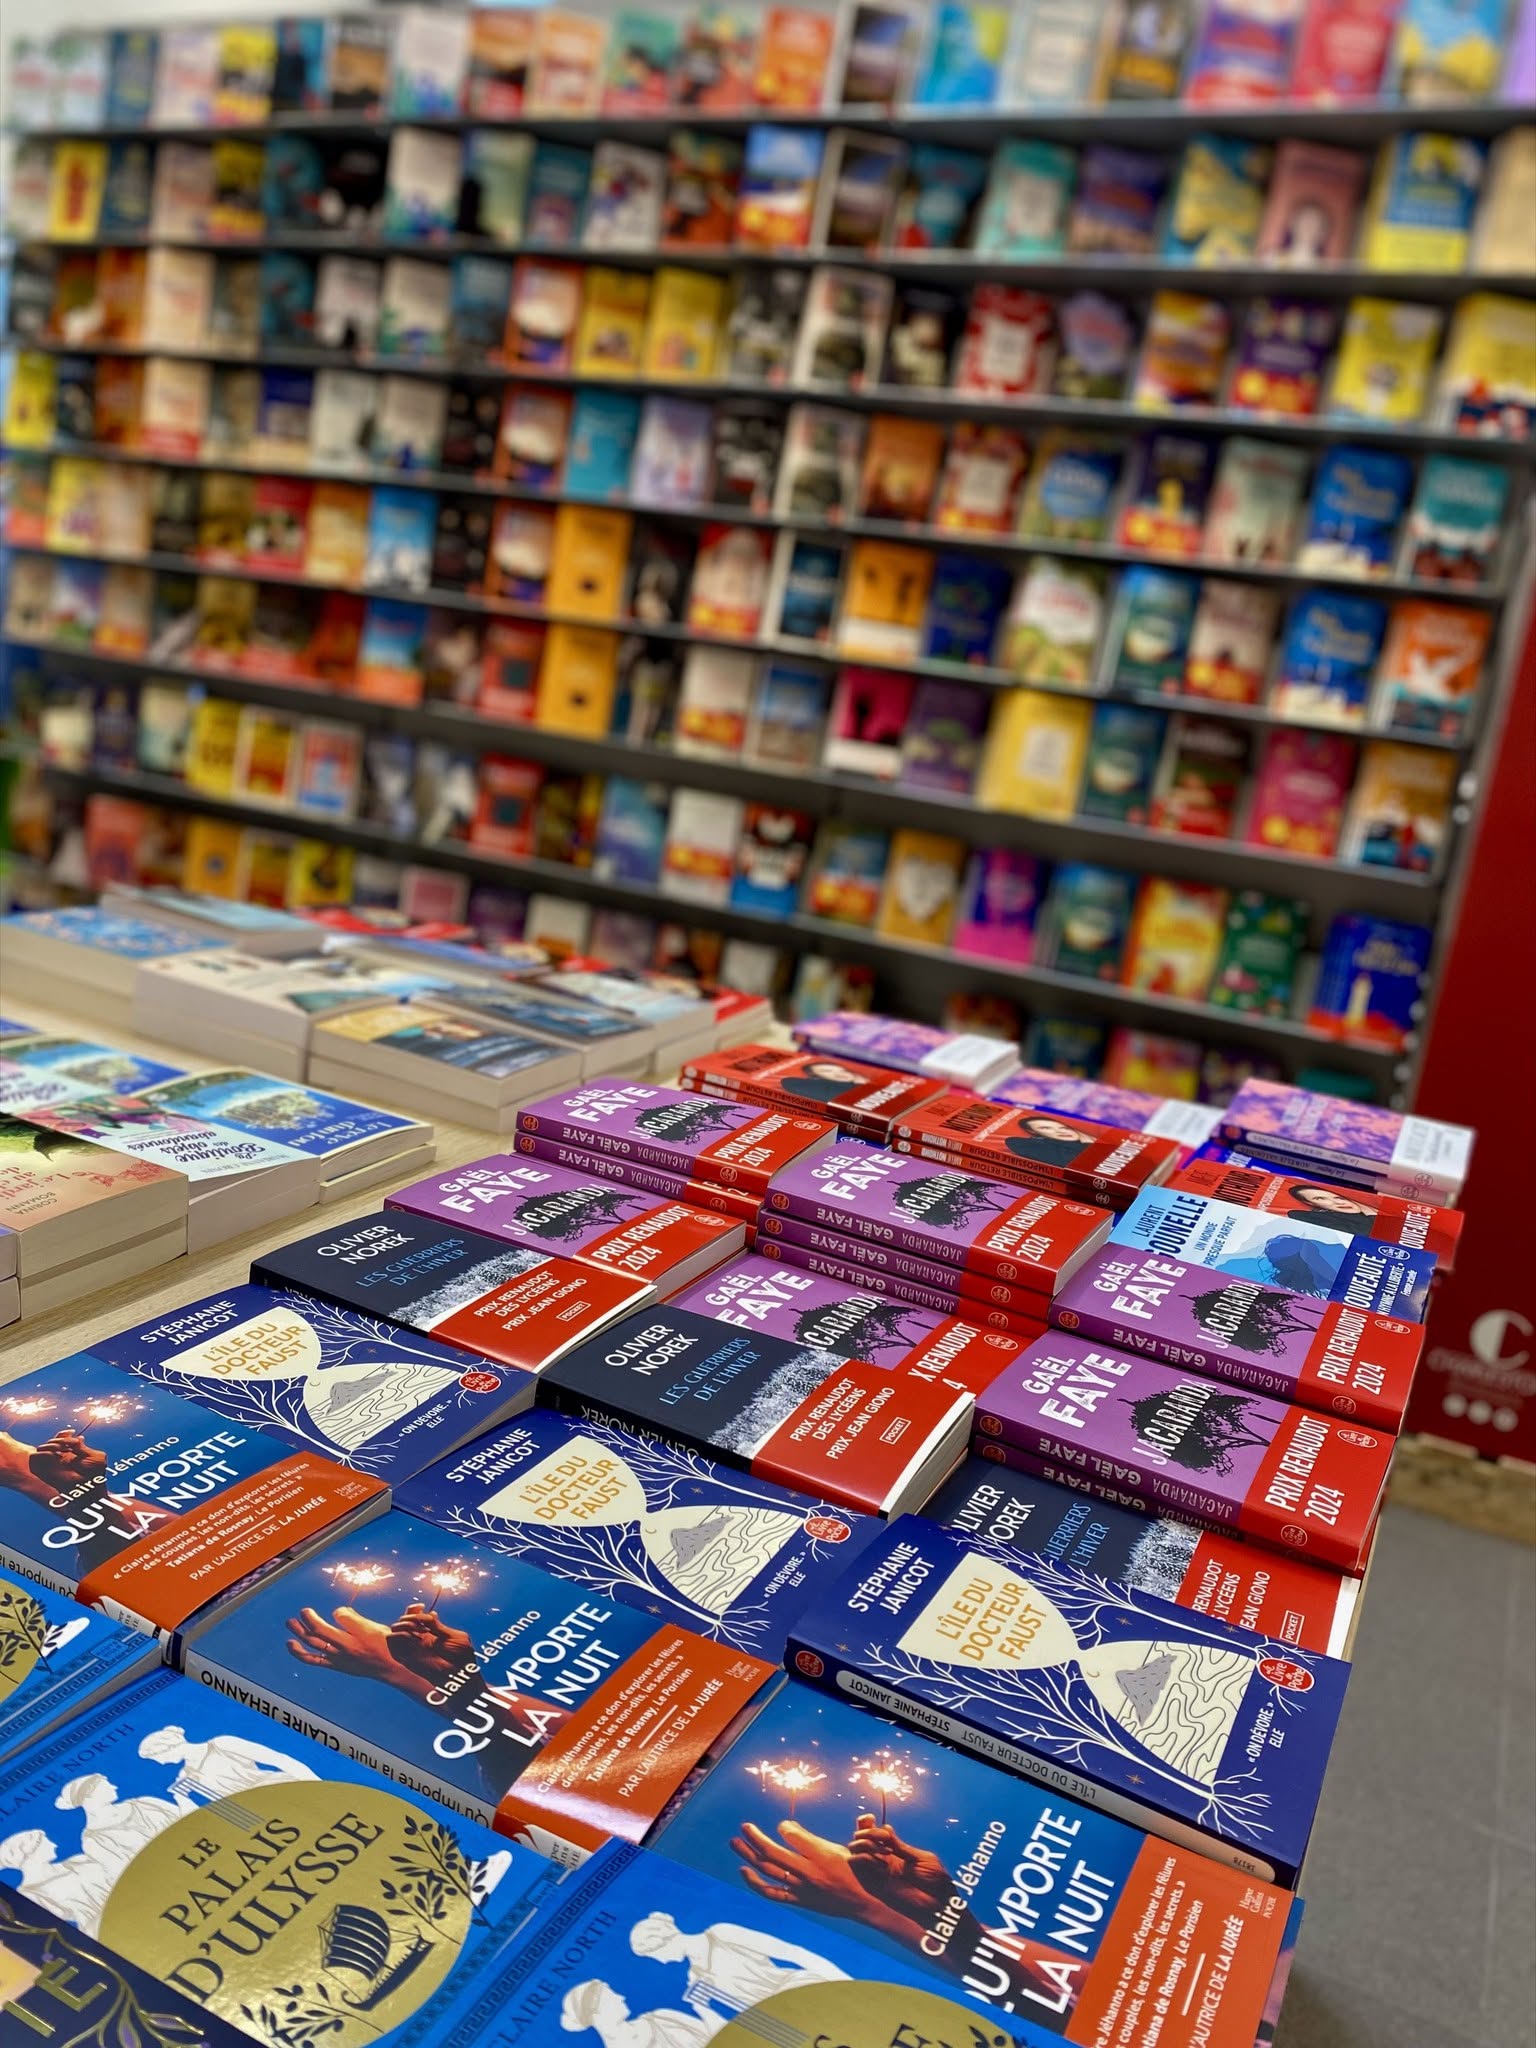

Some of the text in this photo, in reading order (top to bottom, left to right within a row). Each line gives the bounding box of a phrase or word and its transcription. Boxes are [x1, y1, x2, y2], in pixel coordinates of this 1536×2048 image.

[562, 1088, 616, 1108] GAËL
[566, 1086, 659, 1123] FAYE
[628, 1096, 718, 1140] JACARANDA
[738, 1146, 776, 1168] 2024
[810, 1153, 861, 1180] GAËL
[819, 1153, 909, 1201] FAYE
[1093, 1139, 1148, 1177] NOUVEAUTÉ
[438, 1169, 504, 1193] GAËL
[438, 1167, 553, 1214] FAYE
[888, 1170, 976, 1225] JACARANDA
[502, 1182, 618, 1237] JACARANDA
[628, 1204, 696, 1245] RENAUDOT
[1006, 1194, 1063, 1235] RENAUDOT
[1132, 1204, 1168, 1239] LAURENT
[1398, 1210, 1432, 1250] OUVEAUTÉ
[317, 1225, 395, 1257] OLIVIER
[339, 1233, 416, 1265] NOREK
[1016, 1233, 1056, 1262] 2024
[1200, 1221, 1219, 1245] MONDE
[1202, 1215, 1239, 1267] PRESQUE PARFAIT
[356, 1238, 465, 1288] LES GUERRIERS
[412, 1249, 469, 1275] L'HIVER
[618, 1244, 663, 1272] 2024
[1093, 1261, 1138, 1293] GAËL
[497, 1270, 555, 1303] RENAUDOT
[520, 1276, 561, 1305] LYCÉENS
[528, 1278, 588, 1316] JEAN GIONO
[704, 1273, 764, 1307] GAËL
[715, 1271, 816, 1331] FAYE
[1110, 1259, 1188, 1320] FAYE
[140, 1300, 237, 1344] STÉPHANIE
[167, 1308, 239, 1346] JANICOT
[562, 1302, 588, 1321] POCKET
[1196, 1278, 1266, 1350] JACARANDA
[202, 1322, 278, 1363] L'ÎLE DU
[211, 1325, 308, 1376] DOCTEUR
[244, 1340, 309, 1376] FAUST
[604, 1324, 675, 1367] OLIVIER
[630, 1333, 699, 1376] NOREK
[916, 1322, 983, 1371] RENAUDOT
[1112, 1328, 1290, 1393] GAËL FAYE JACARANDA
[1316, 1308, 1369, 1385] PRIX RENAUDOT
[658, 1336, 752, 1405] LES GUERRIERS
[693, 1350, 762, 1402] DE L'HIVER
[1022, 1355, 1077, 1395] GAËL
[1038, 1352, 1133, 1429] FAYE
[1352, 1360, 1387, 1396] 2024
[426, 1415, 445, 1430] ELLE
[789, 1377, 856, 1442] PRIX RENAUDOT
[812, 1386, 867, 1441] DES LYCÉENS
[826, 1387, 896, 1460] PRIX JEAN GIONO
[886, 1420, 907, 1442] POCKET
[1131, 1377, 1218, 1466] JACARANDA
[48, 1436, 180, 1509] Claire Jéhanno
[446, 1428, 533, 1483] STÉPHANIE
[475, 1439, 540, 1485] JANICOT
[1039, 1437, 1234, 1519] GAËL FAYE JACARANDA
[1264, 1415, 1331, 1512] PRIX RENAUDOT
[41, 1431, 247, 1549] QU'IMPORTE
[107, 1459, 241, 1541] LA NUIT
[520, 1454, 589, 1504] L'ÎLE DU
[533, 1458, 621, 1521] DOCTEUR
[570, 1475, 628, 1520] FAUST
[293, 1494, 328, 1519] JURÉE
[1304, 1484, 1345, 1526] 2024
[1069, 1522, 1111, 1567] L'HIVER
[788, 1571, 807, 1588] ELLE
[847, 1541, 920, 1613] STÉPHANIE
[879, 1556, 935, 1616] JANICOT
[1191, 1558, 1224, 1613] RENAUDOT
[1213, 1571, 1241, 1616] LYCÉENS
[1247, 1571, 1271, 1605] GIONO
[935, 1577, 995, 1641] L'ÎLE DU
[959, 1582, 1029, 1662] DOCTEUR
[997, 1603, 1048, 1661] FAUST
[1285, 1614, 1299, 1641] POCKET
[425, 1608, 542, 1707] Claire Jéhanno
[431, 1600, 614, 1761] QU'IMPORTE
[200, 1669, 342, 1752] CLAIRE JEHANNO
[501, 1639, 622, 1749] LA NUIT
[695, 1677, 726, 1708] JURÉE
[61, 1723, 136, 1773] NORTH
[585, 1666, 695, 1784] Tatiana Parisien
[848, 1677, 1052, 1779] DOCTEUR FAUST STÉPHANIE JANICOT
[1268, 1727, 1286, 1750] ELLE
[177, 1836, 223, 1871] LE
[158, 1817, 303, 1937] PALAIS
[920, 1819, 1008, 1958] Claire Jéhanno
[164, 1811, 386, 2004] D'ULYSSE
[1178, 1898, 1205, 1943] Parisien
[551, 1910, 618, 1979] NORTH
[1021, 1859, 1117, 2015] LA NUIT
[1220, 1913, 1245, 1955] JURÉE
[1096, 1987, 1127, 2037] Jéhanno
